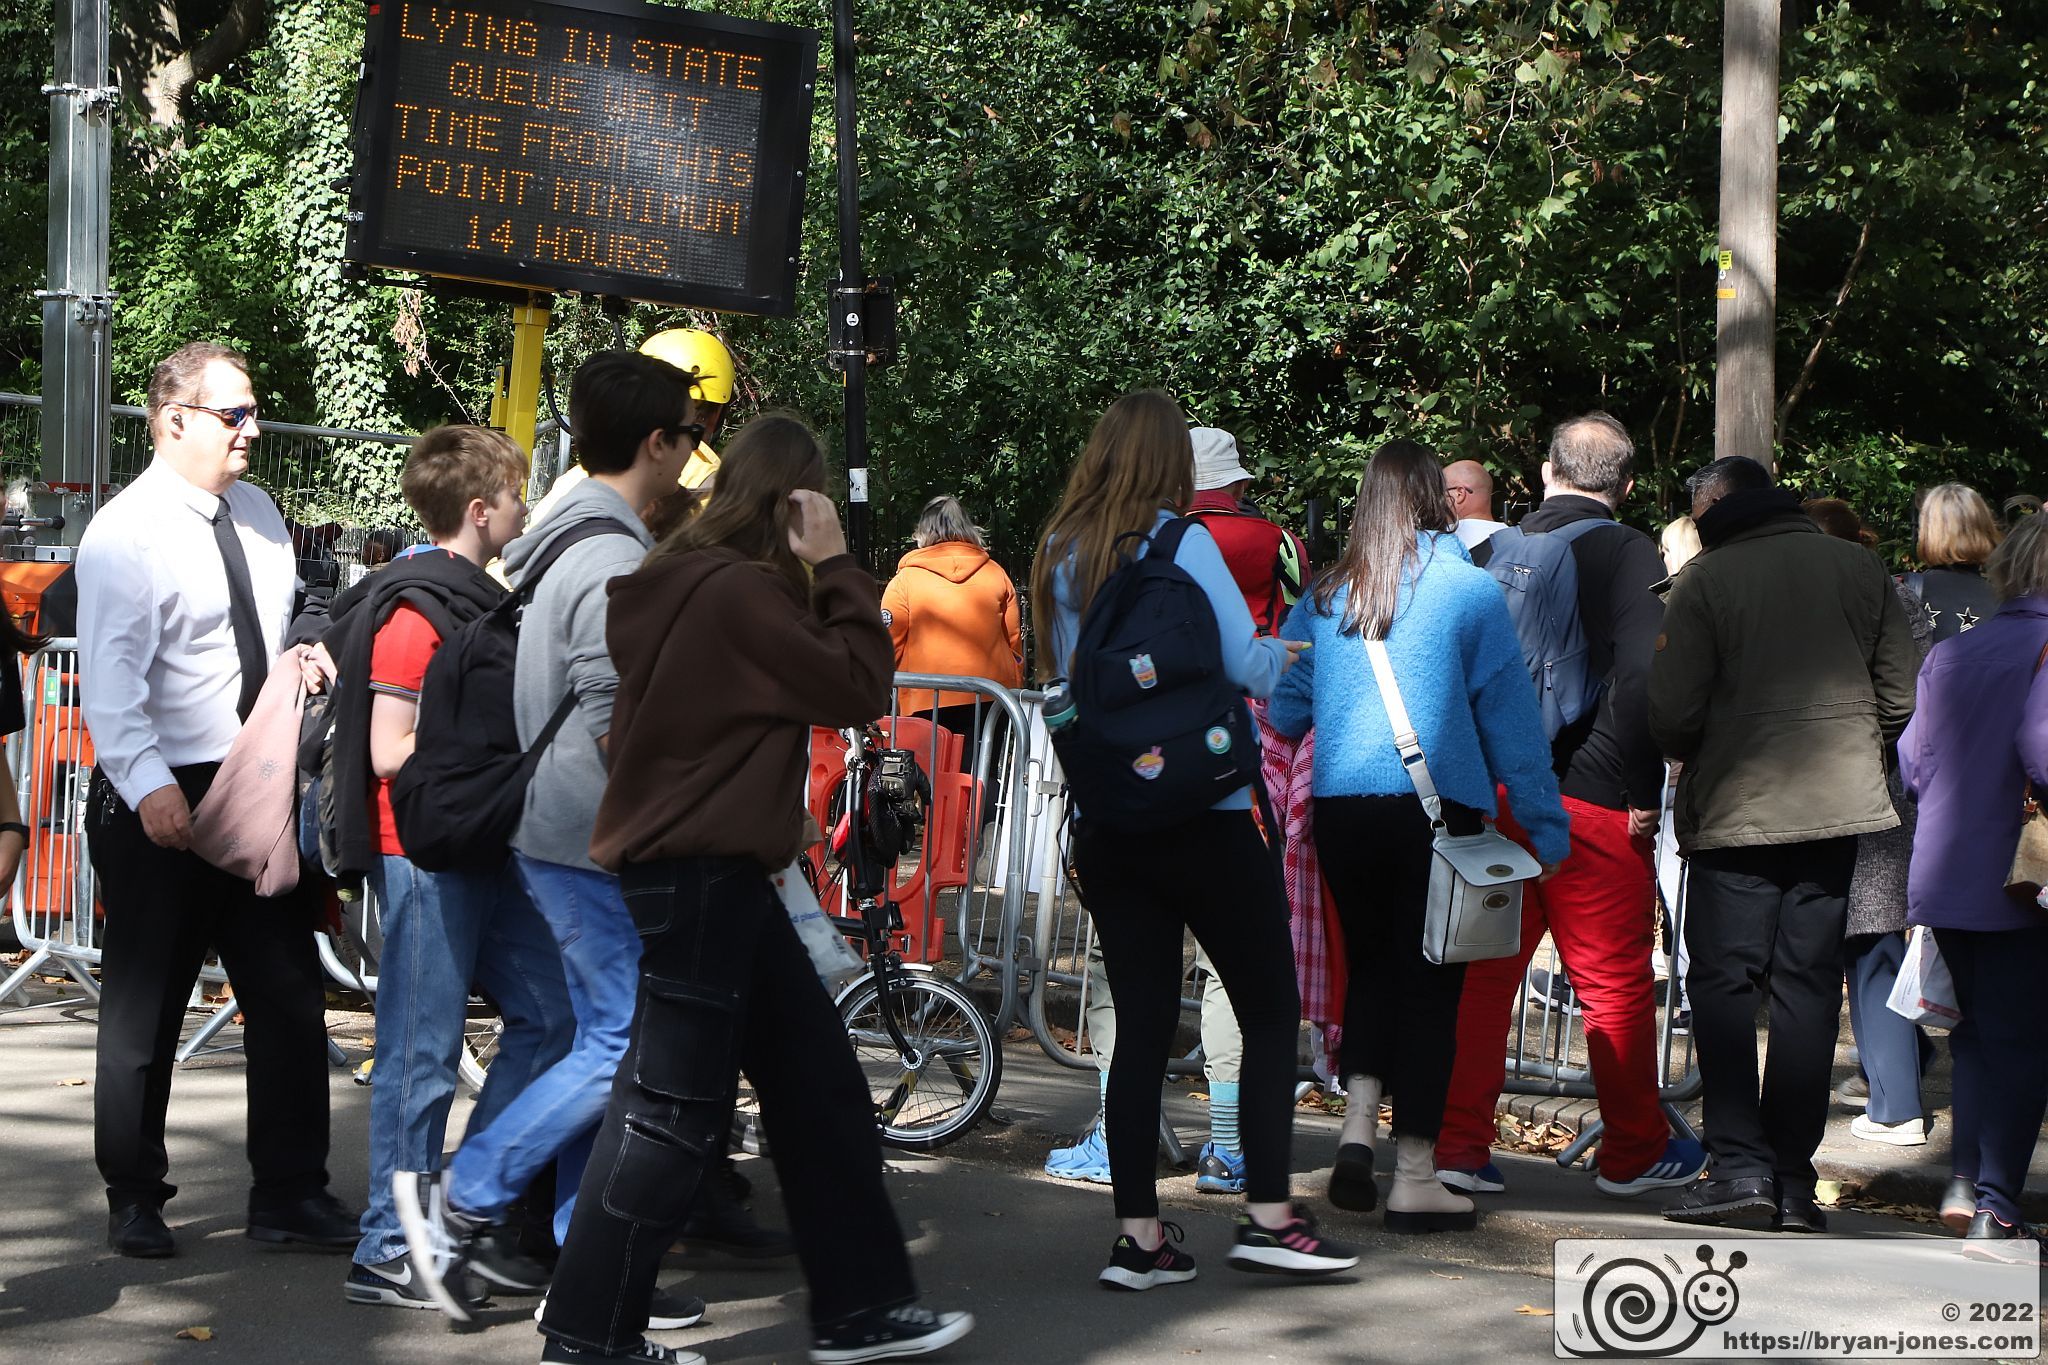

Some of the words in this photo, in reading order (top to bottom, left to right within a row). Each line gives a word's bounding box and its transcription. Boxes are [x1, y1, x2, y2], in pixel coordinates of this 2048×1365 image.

[400, 3, 540, 58] LYING
[564, 26, 612, 69] IN
[631, 38, 763, 91] STATE
[448, 60, 585, 115] QUEUE
[604, 83, 710, 132] WAIT
[394, 102, 502, 153] TIME
[521, 120, 629, 170] FROM
[651, 136, 755, 188] THIS
[394, 154, 535, 205] POINT
[553, 174, 741, 236] MINIMUM
[467, 214, 515, 255] 14
[533, 222, 671, 276] HOURS
